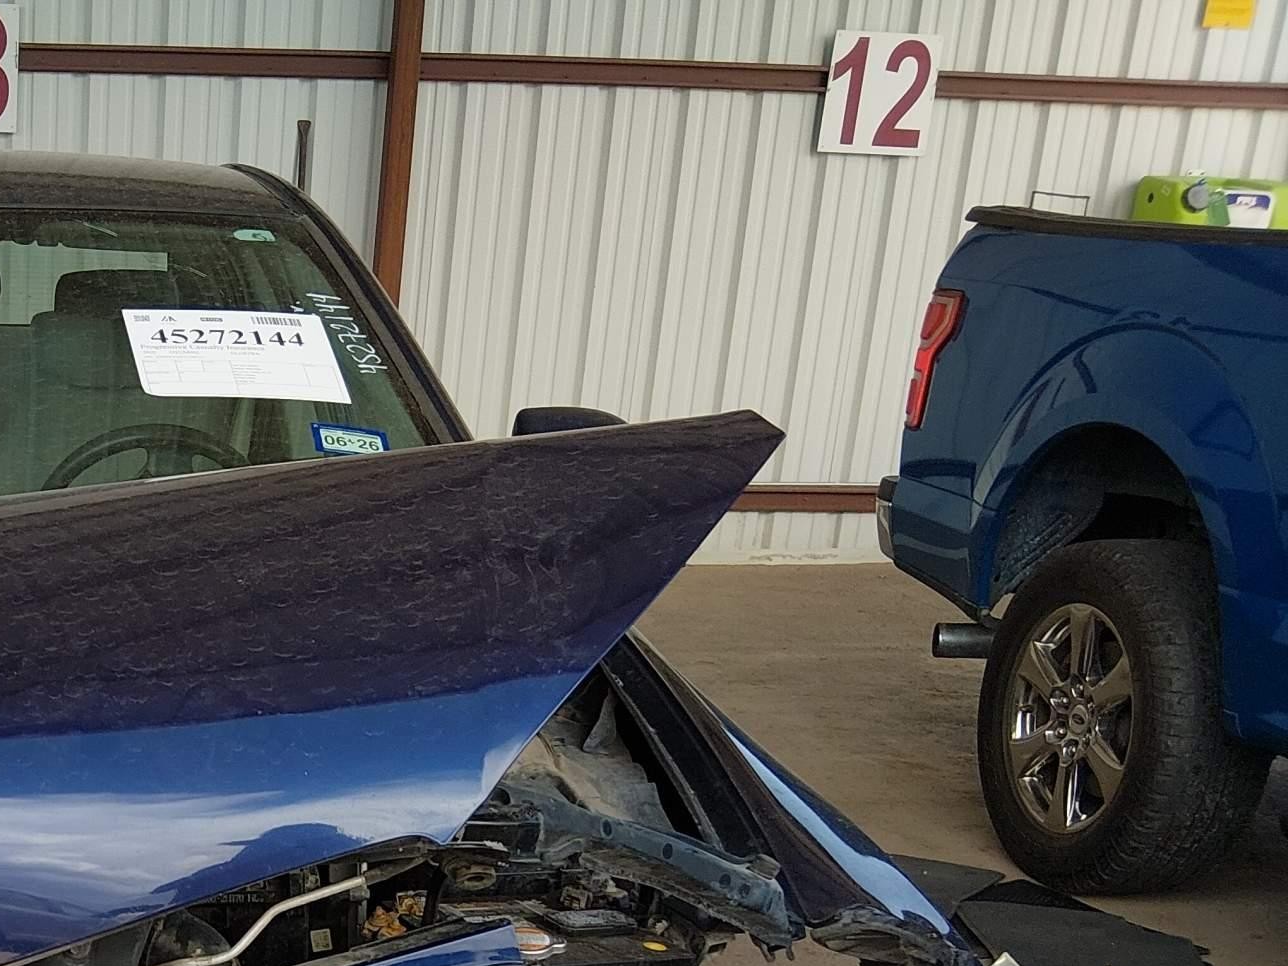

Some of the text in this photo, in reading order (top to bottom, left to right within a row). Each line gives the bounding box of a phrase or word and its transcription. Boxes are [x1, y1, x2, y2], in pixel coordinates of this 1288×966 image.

[832, 37, 931, 147] 12
[150, 328, 305, 347] 45272144
[305, 292, 388, 374] 45272144
[324, 435, 380, 452] 06 26
